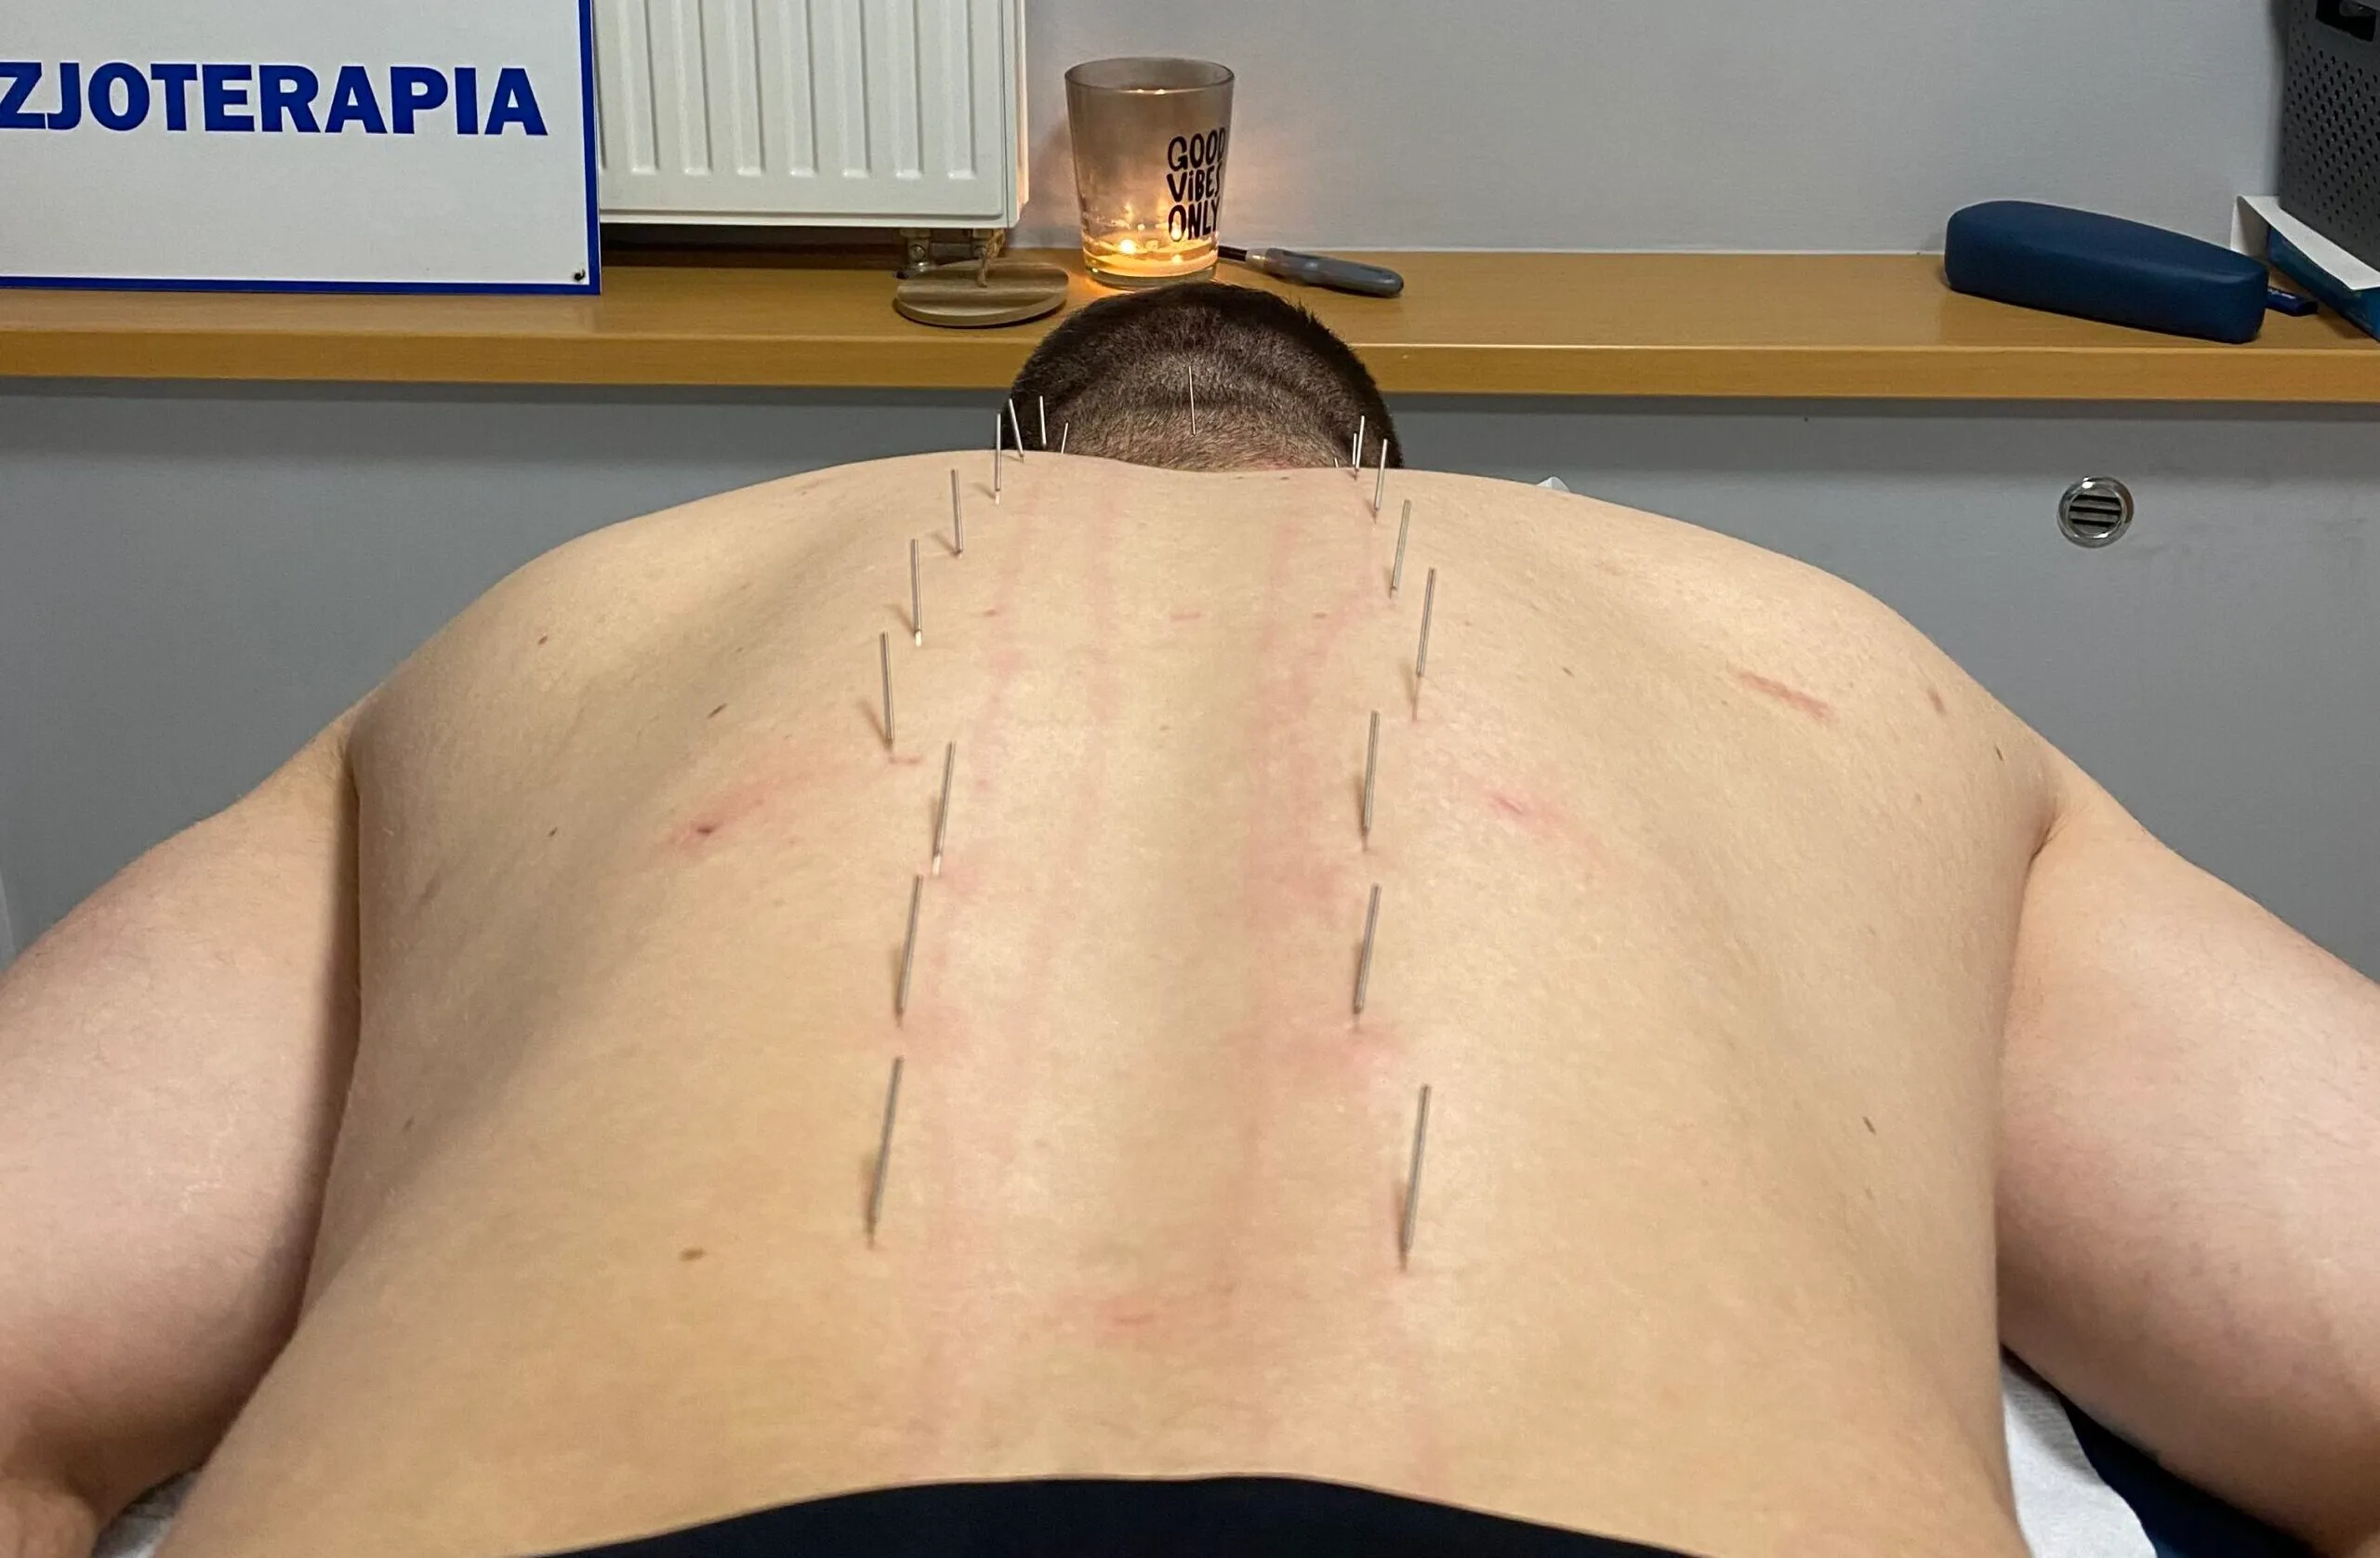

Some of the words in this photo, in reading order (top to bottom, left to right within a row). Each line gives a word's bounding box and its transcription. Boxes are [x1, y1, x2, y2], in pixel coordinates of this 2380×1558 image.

[0, 61, 549, 137] ZJOTERAPIA
[1168, 126, 1226, 172] GOOD
[1168, 196, 1220, 242] ONLY
